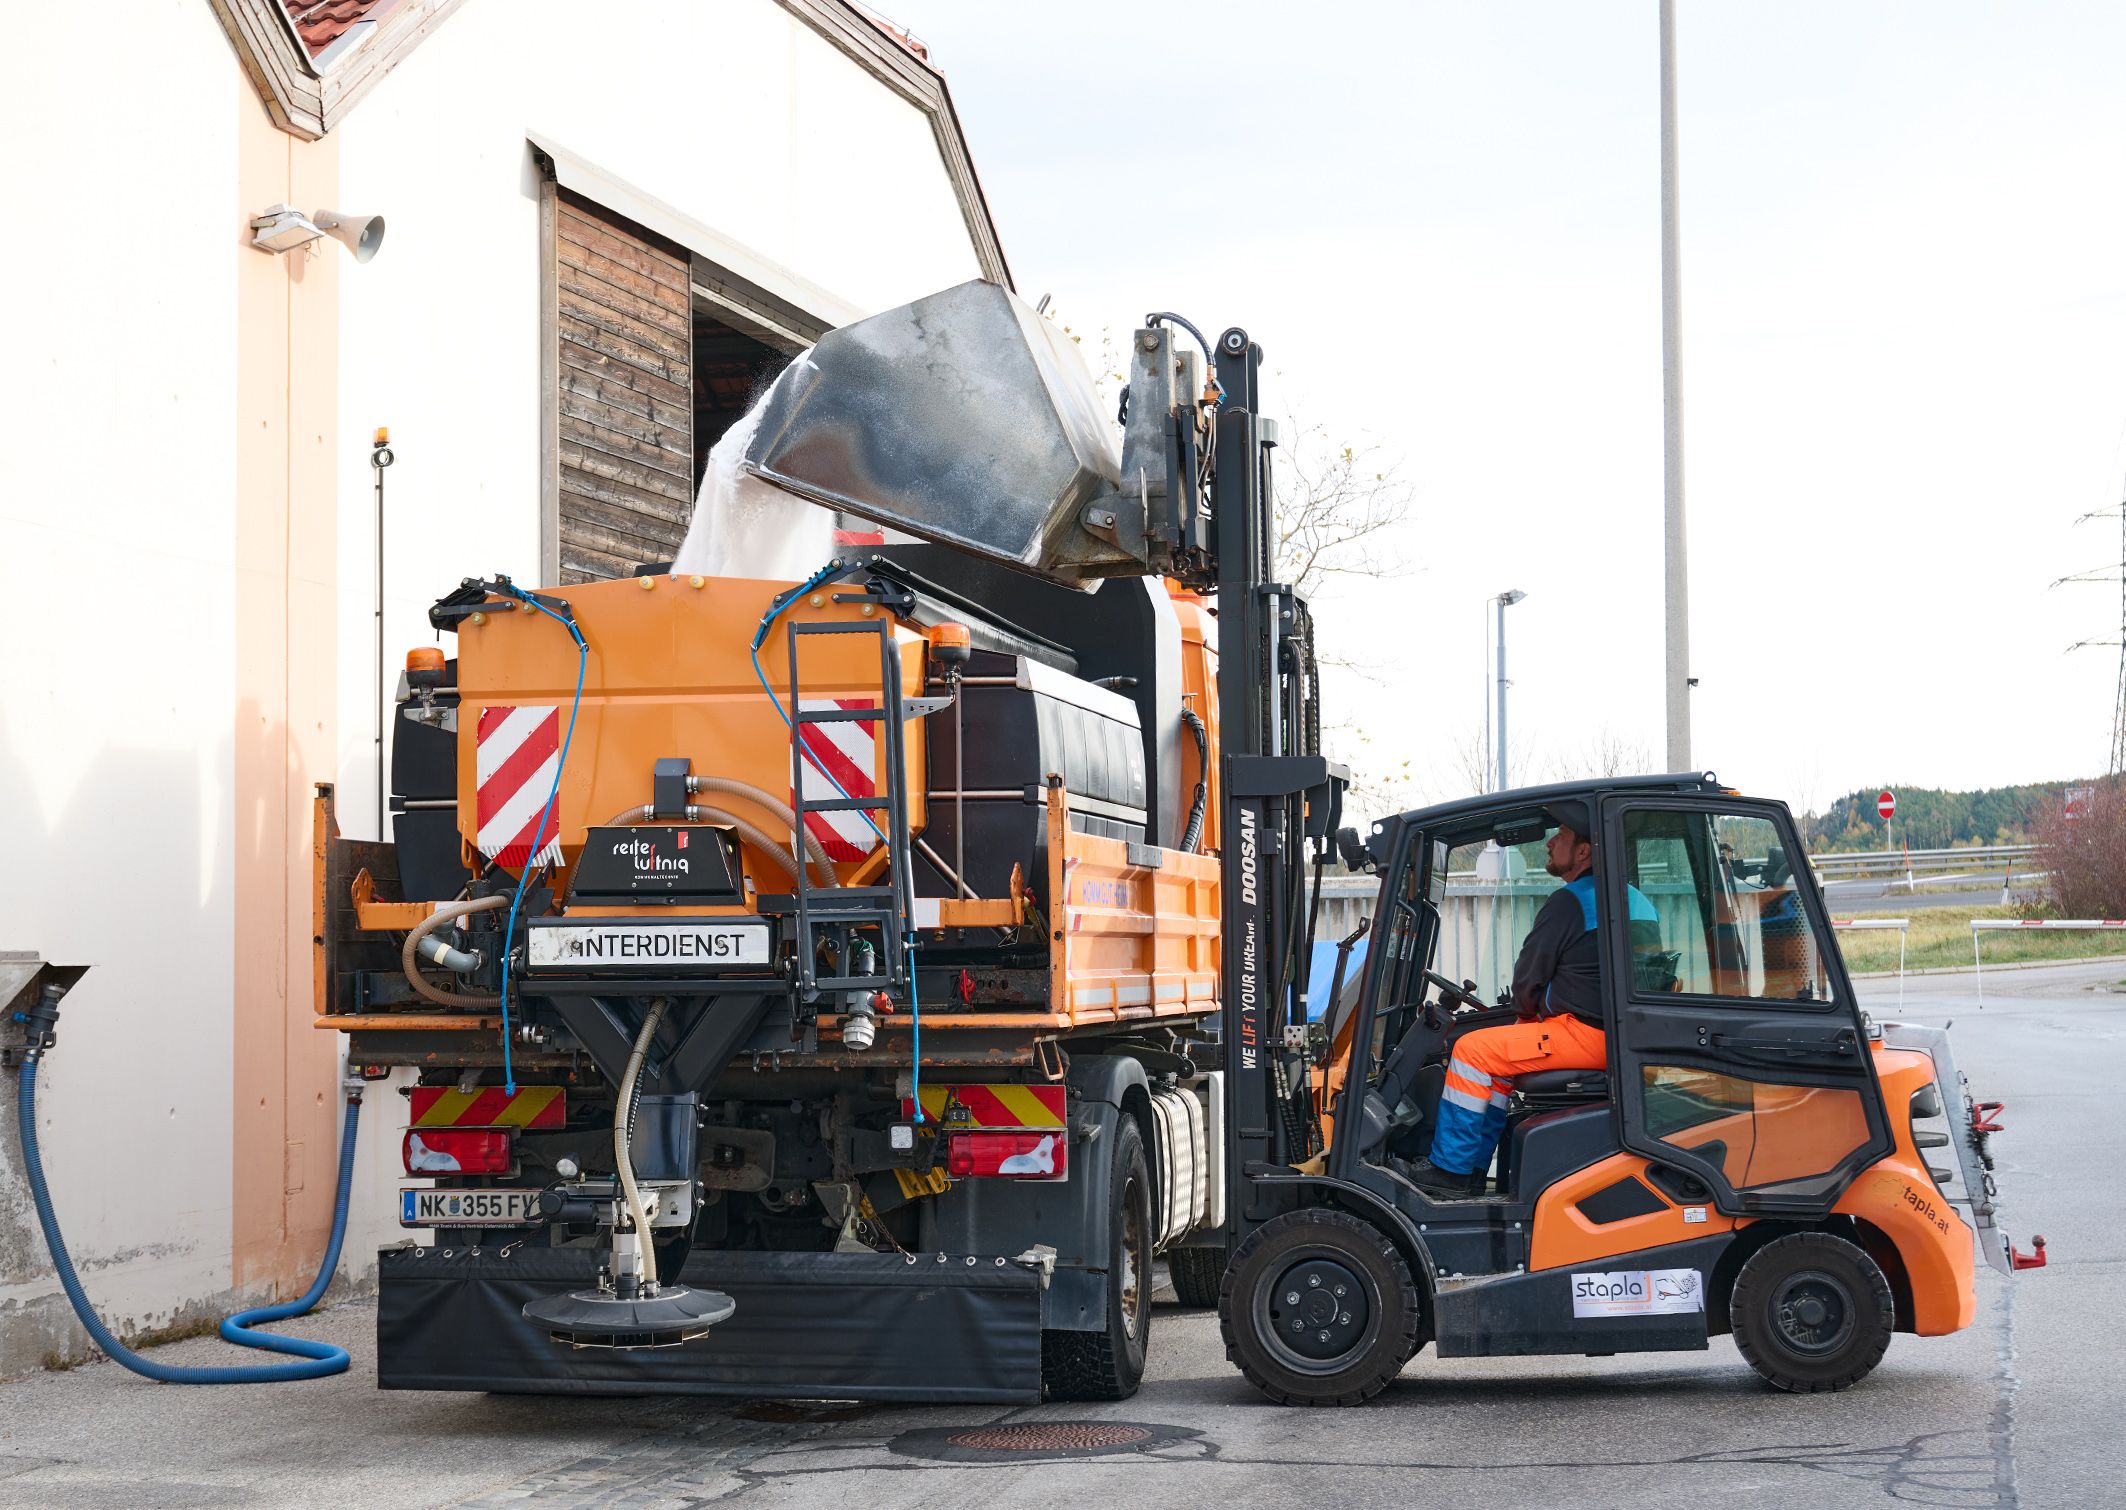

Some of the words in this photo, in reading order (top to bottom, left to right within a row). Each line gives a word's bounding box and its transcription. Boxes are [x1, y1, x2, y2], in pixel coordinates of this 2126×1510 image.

[1240, 808, 1256, 906] DOOSAN
[571, 934, 745, 957] INTERDIENST
[1244, 914, 1256, 972] DREAM
[1242, 974, 1256, 1012] YOUR
[1242, 1014, 1256, 1046] LIFT
[1242, 1048, 1256, 1069] WE
[420, 1195, 446, 1217] NK
[462, 1195, 502, 1217] 355
[1898, 1186, 1950, 1235] tapla.at
[1576, 1275, 1642, 1301] stapla
